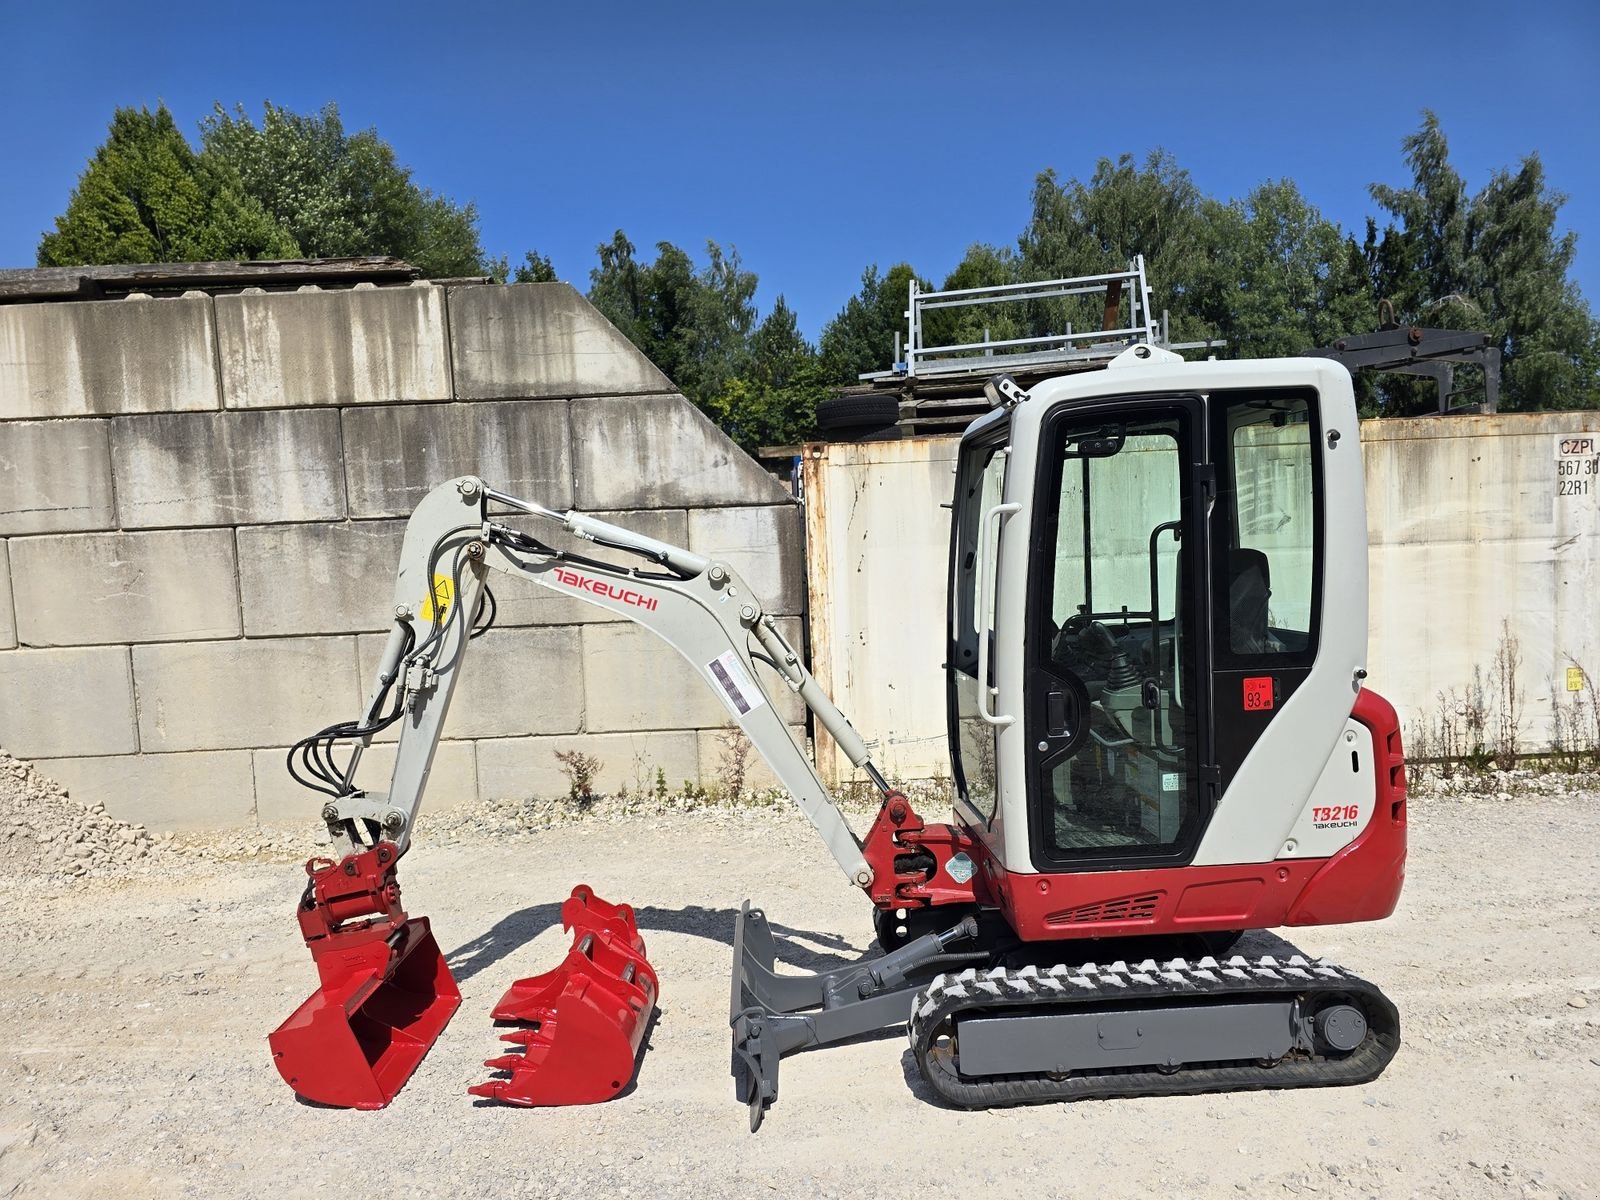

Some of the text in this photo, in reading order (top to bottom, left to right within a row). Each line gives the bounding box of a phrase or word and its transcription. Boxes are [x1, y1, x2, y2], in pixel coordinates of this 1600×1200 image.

[1558, 460, 1580, 475] 567
[1559, 480, 1588, 496] 22R1
[1247, 692, 1261, 707] 93
[1312, 804, 1359, 822] TB216
